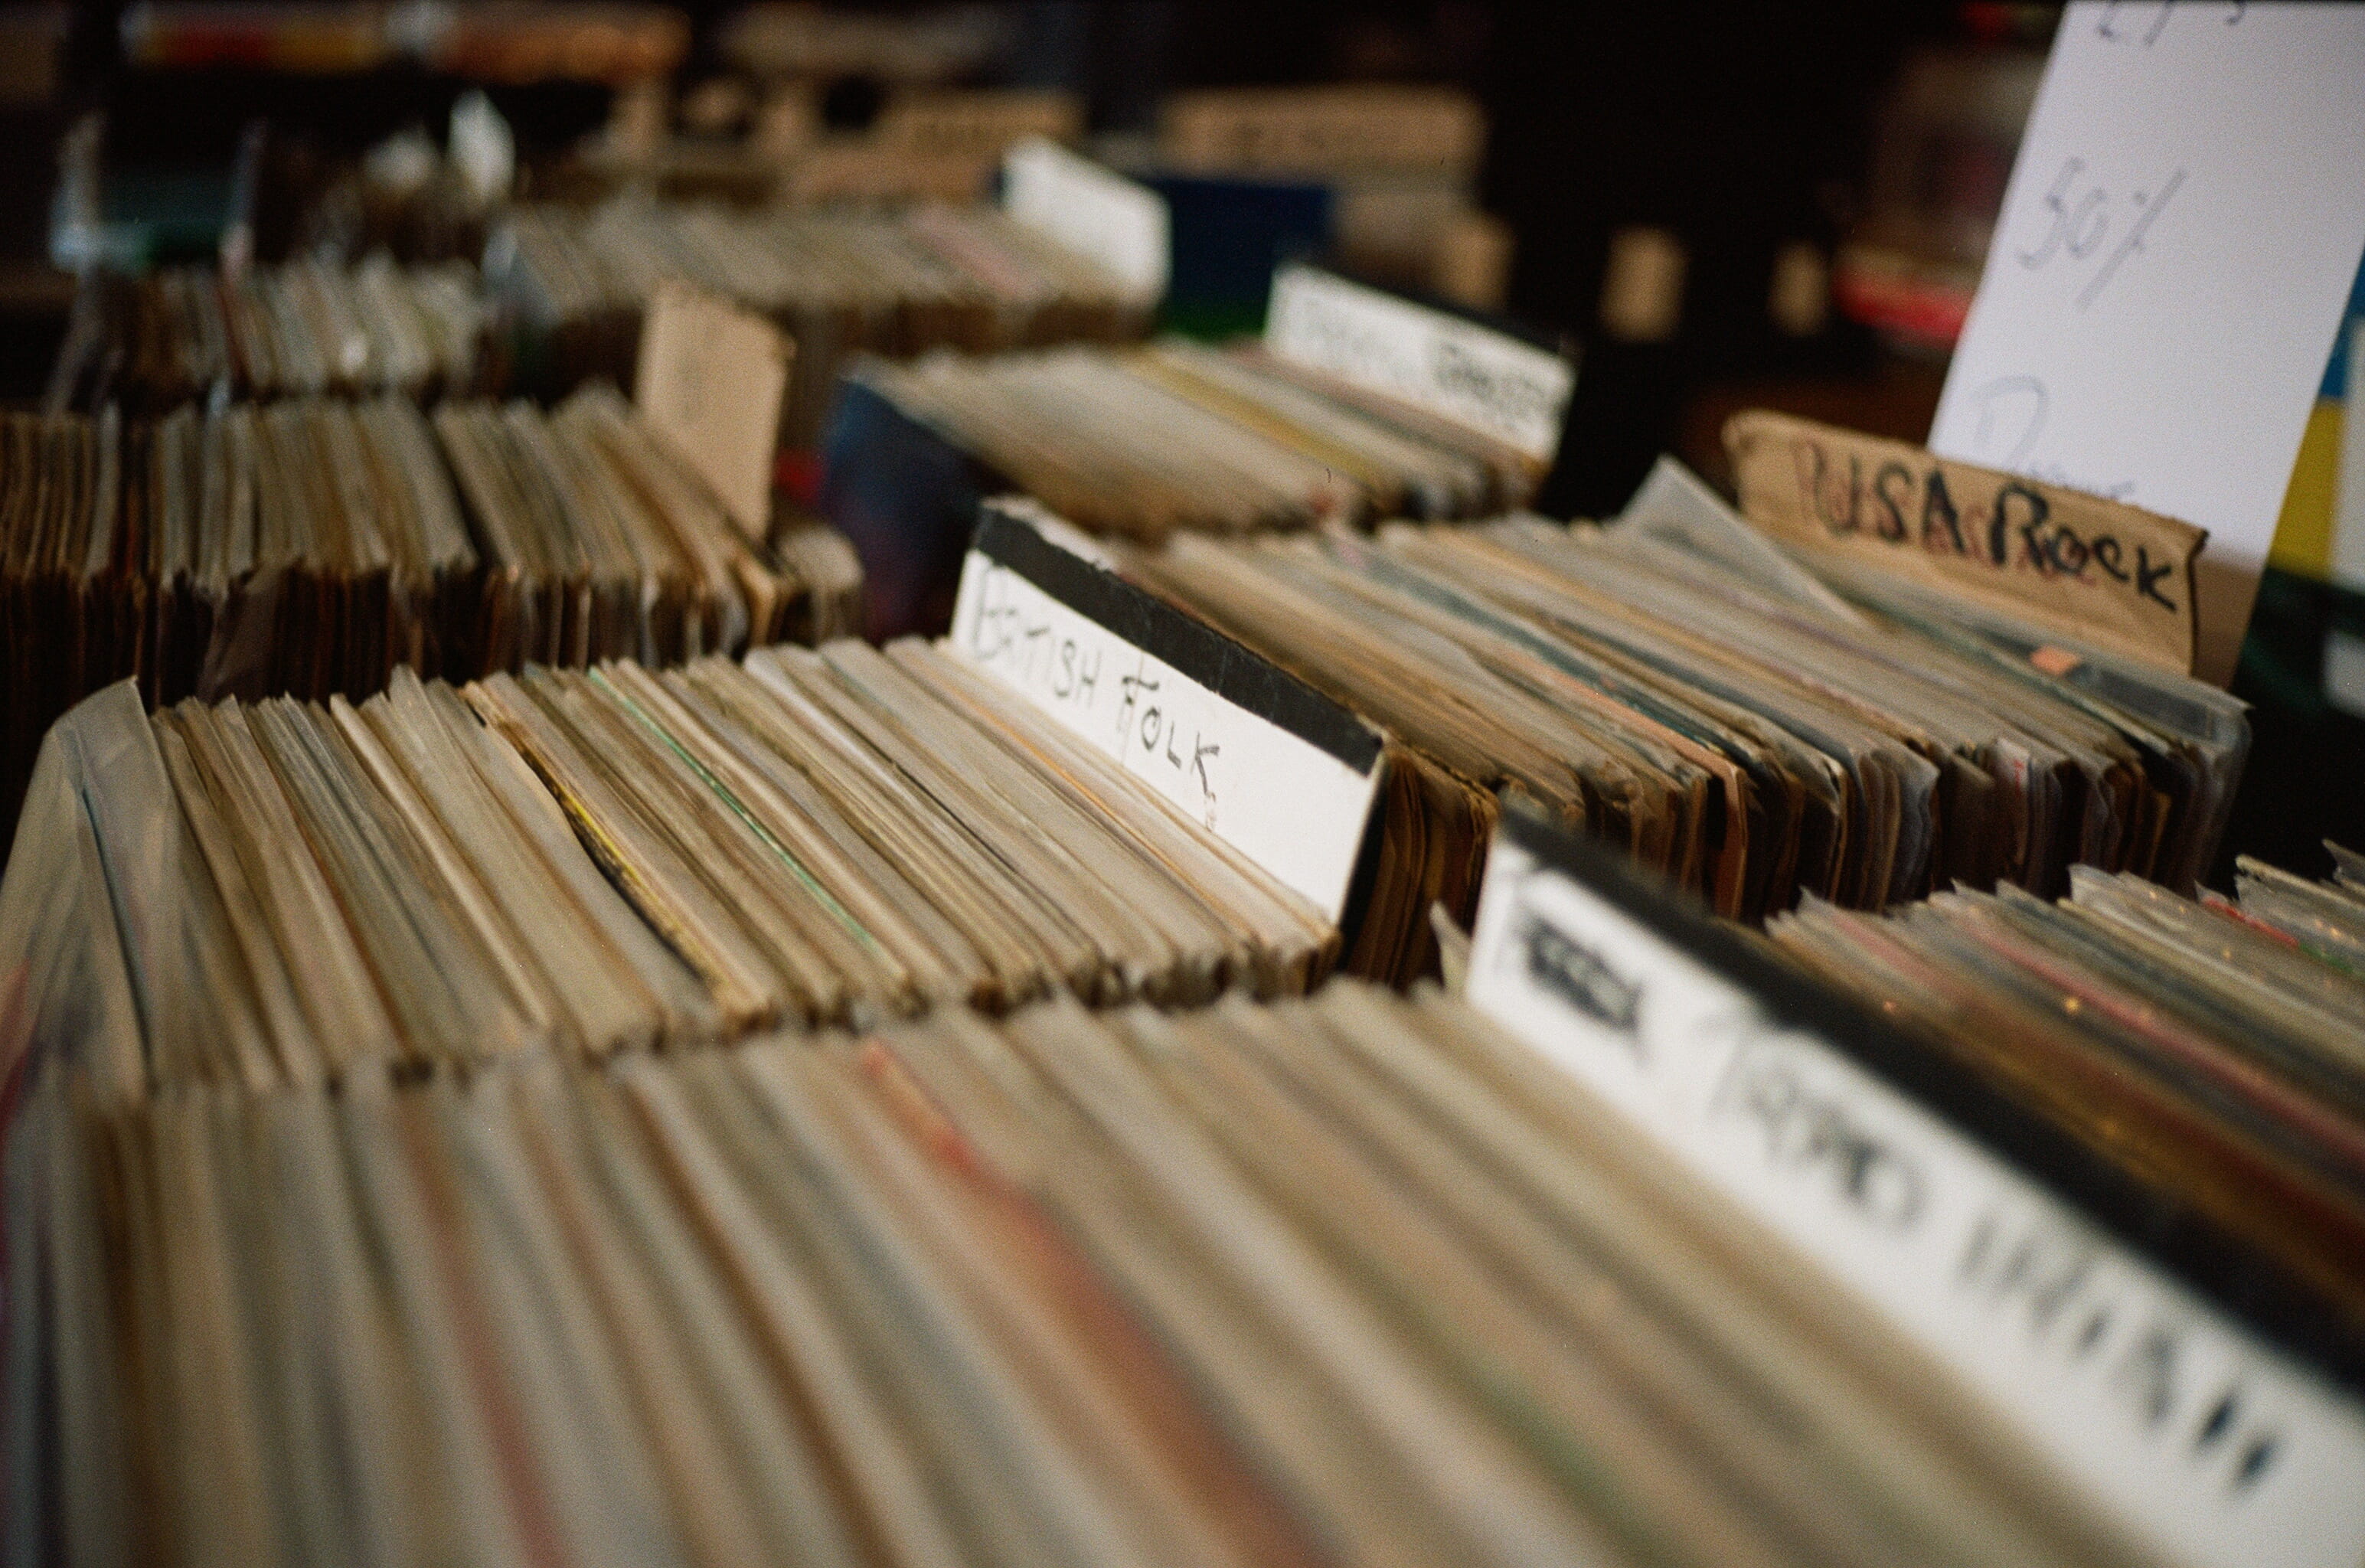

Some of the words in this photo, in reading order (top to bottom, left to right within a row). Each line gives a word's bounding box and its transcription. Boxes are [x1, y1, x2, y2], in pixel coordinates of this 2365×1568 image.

[2015, 157, 2187, 312] 50%
[1810, 439, 1965, 554] USA
[968, 567, 1104, 709] BRTISH
[1115, 675, 1221, 795] FOLK
